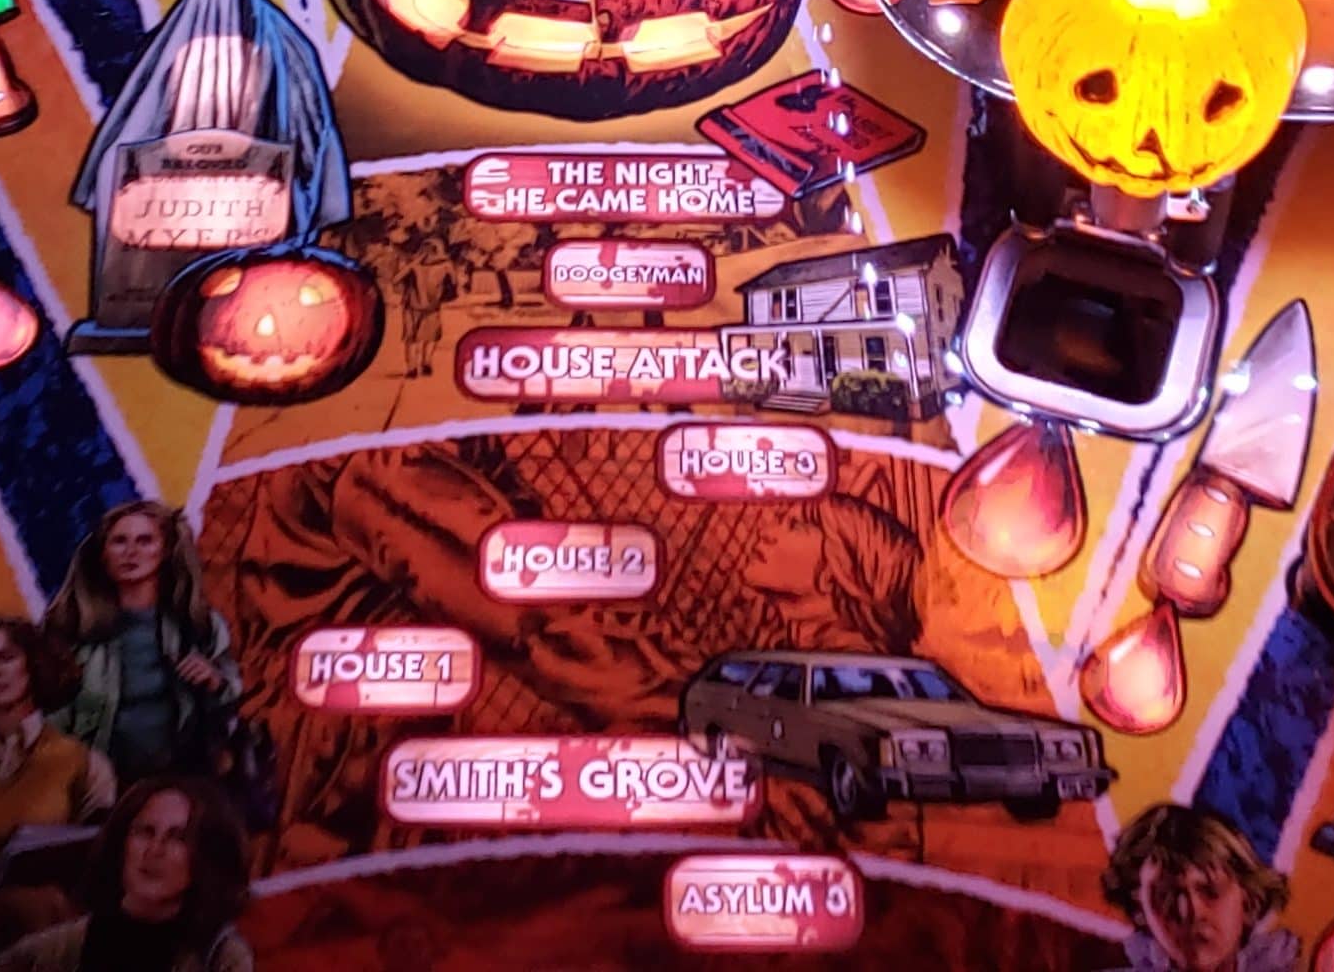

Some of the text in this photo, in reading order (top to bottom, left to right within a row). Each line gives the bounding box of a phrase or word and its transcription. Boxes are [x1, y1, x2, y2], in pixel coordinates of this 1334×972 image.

[548, 161, 712, 186] THE NIGHT
[135, 199, 265, 218] JUDITH
[504, 188, 755, 215] HE CAME HOME
[555, 263, 703, 286] BOOGEYMAN
[471, 347, 790, 381] HOUSE ATTACK
[680, 452, 818, 477] HOUSE 3
[501, 546, 645, 573] HOUSE 2
[310, 652, 452, 682] HOUSE 1
[392, 758, 750, 801] SMITH'S GROVE
[680, 883, 813, 917] ASYLUM
